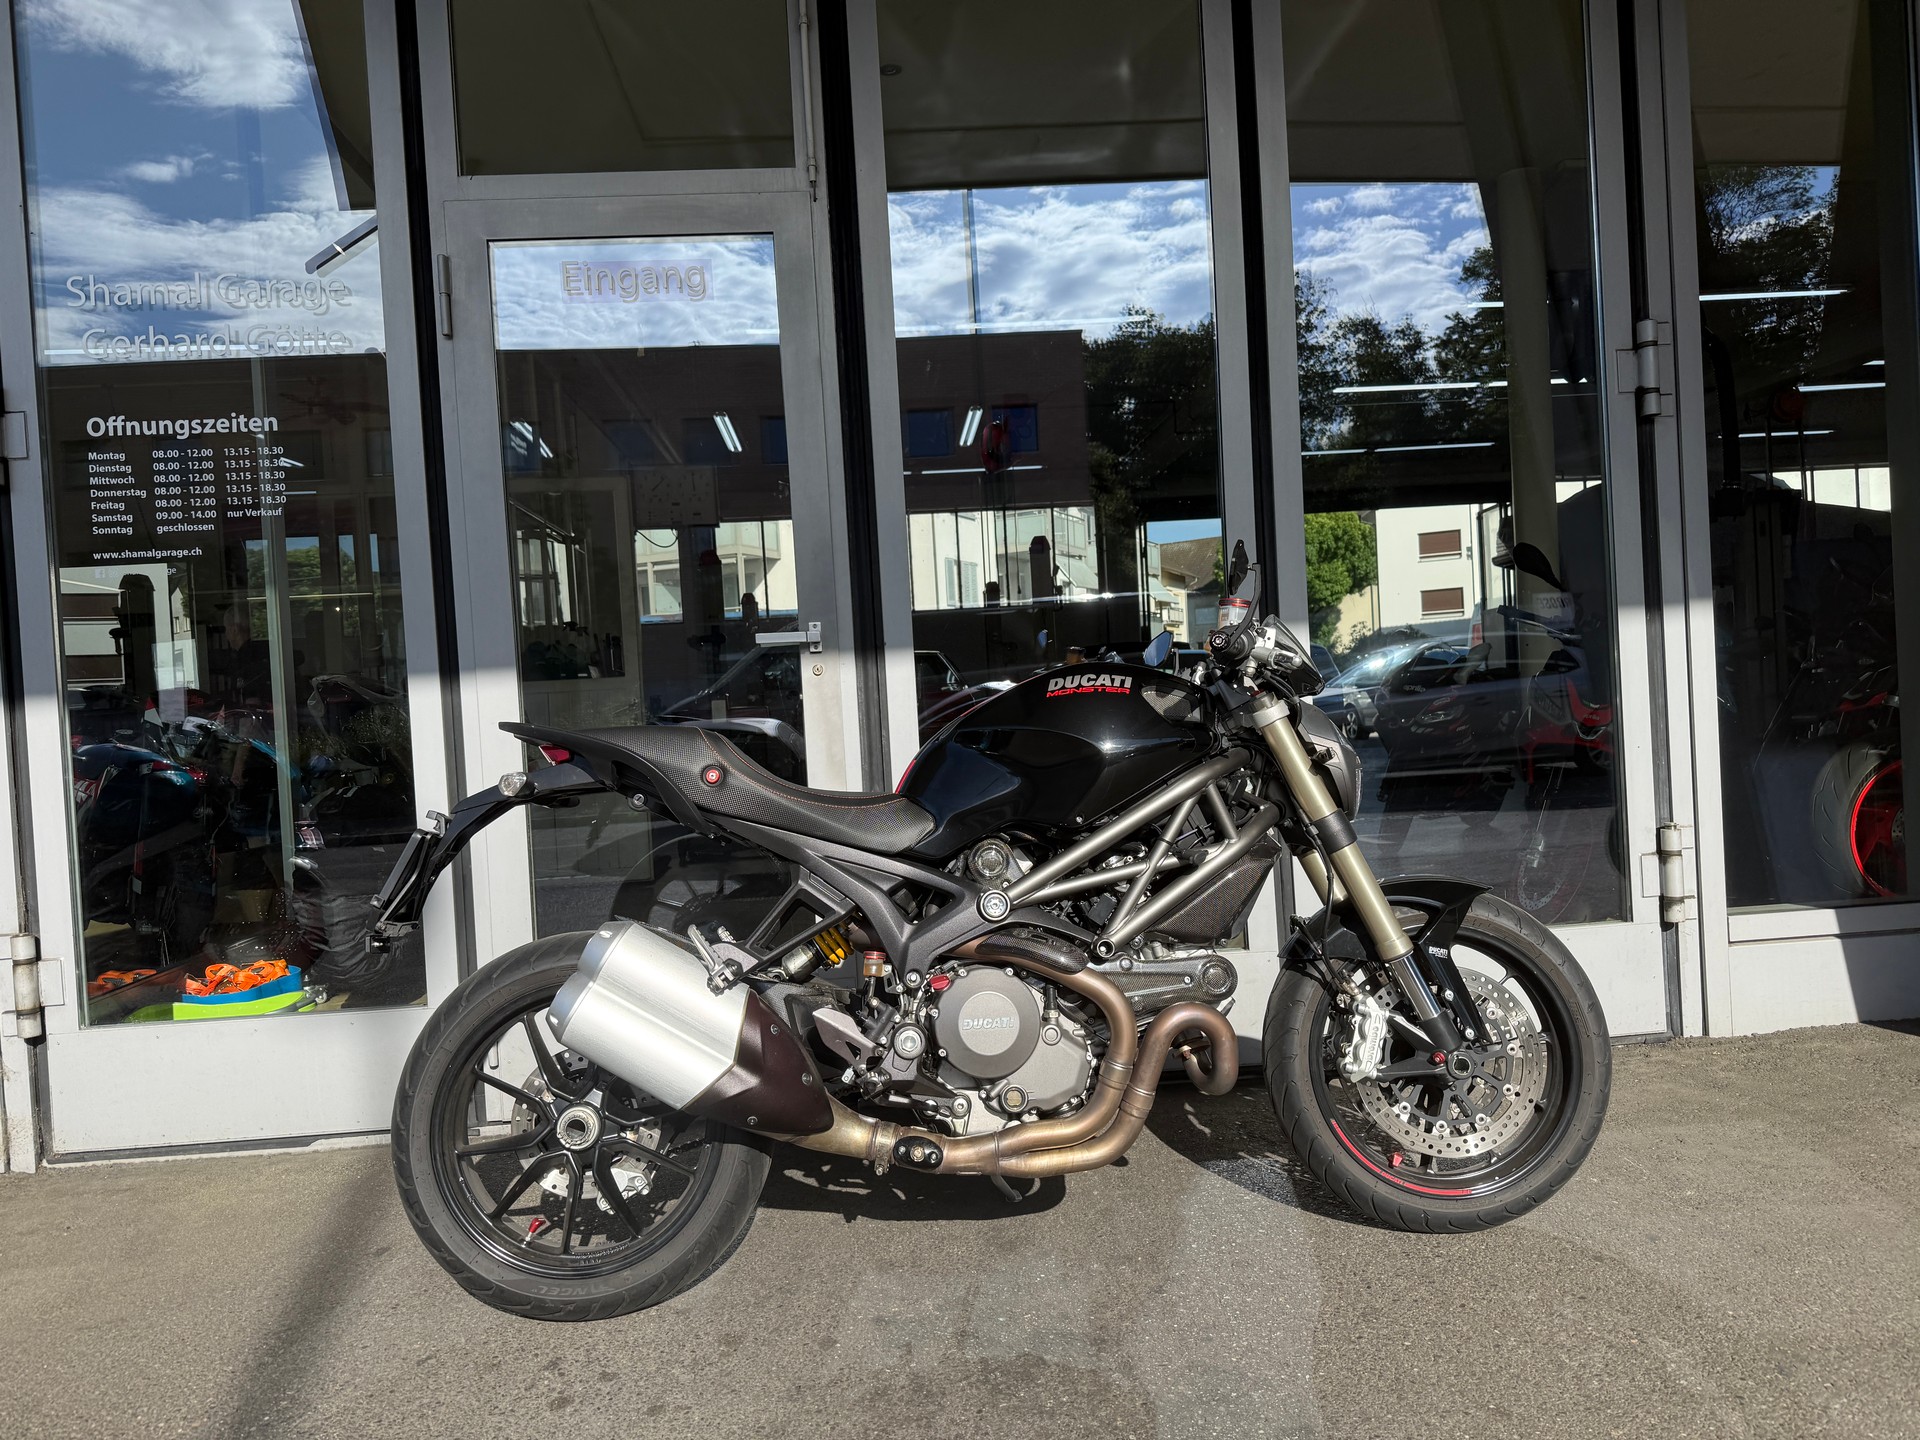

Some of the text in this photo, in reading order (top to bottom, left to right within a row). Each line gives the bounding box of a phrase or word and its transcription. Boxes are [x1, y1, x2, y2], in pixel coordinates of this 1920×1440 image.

[562, 260, 706, 298] Eingang
[65, 272, 347, 310] Shamal Garage
[81, 322, 347, 360] Gerhard Götte
[89, 453, 125, 461] Montag
[153, 450, 178, 458] 08.00
[224, 448, 249, 456] 13.15
[258, 447, 283, 455] 18.30
[89, 465, 131, 473] Dienstag
[153, 462, 179, 470] 08.00
[188, 461, 213, 469] 12.00
[225, 460, 250, 468] 13.15
[90, 476, 134, 485] Mittwoch
[259, 471, 285, 480] 18.30
[91, 489, 146, 498] Donnerstag
[155, 487, 181, 495] 08.00
[226, 485, 252, 493] 13.15
[260, 483, 285, 492] 18.30
[91, 501, 124, 510] Freitag
[156, 499, 182, 507] 08.00
[190, 498, 216, 506] 12.00
[227, 497, 252, 505] 13.15
[261, 495, 286, 504] 18.30
[92, 514, 132, 522] Samstag
[191, 510, 216, 518] 14.00
[245, 508, 282, 517] Verkauf
[93, 523, 214, 535] Sonntag geschlossen
[93, 547, 202, 559] www.shamalgarage.ch
[1048, 674, 1132, 691] DUCATI
[1046, 686, 1131, 698] MONSTER
[962, 1017, 1015, 1030] DUCATI
